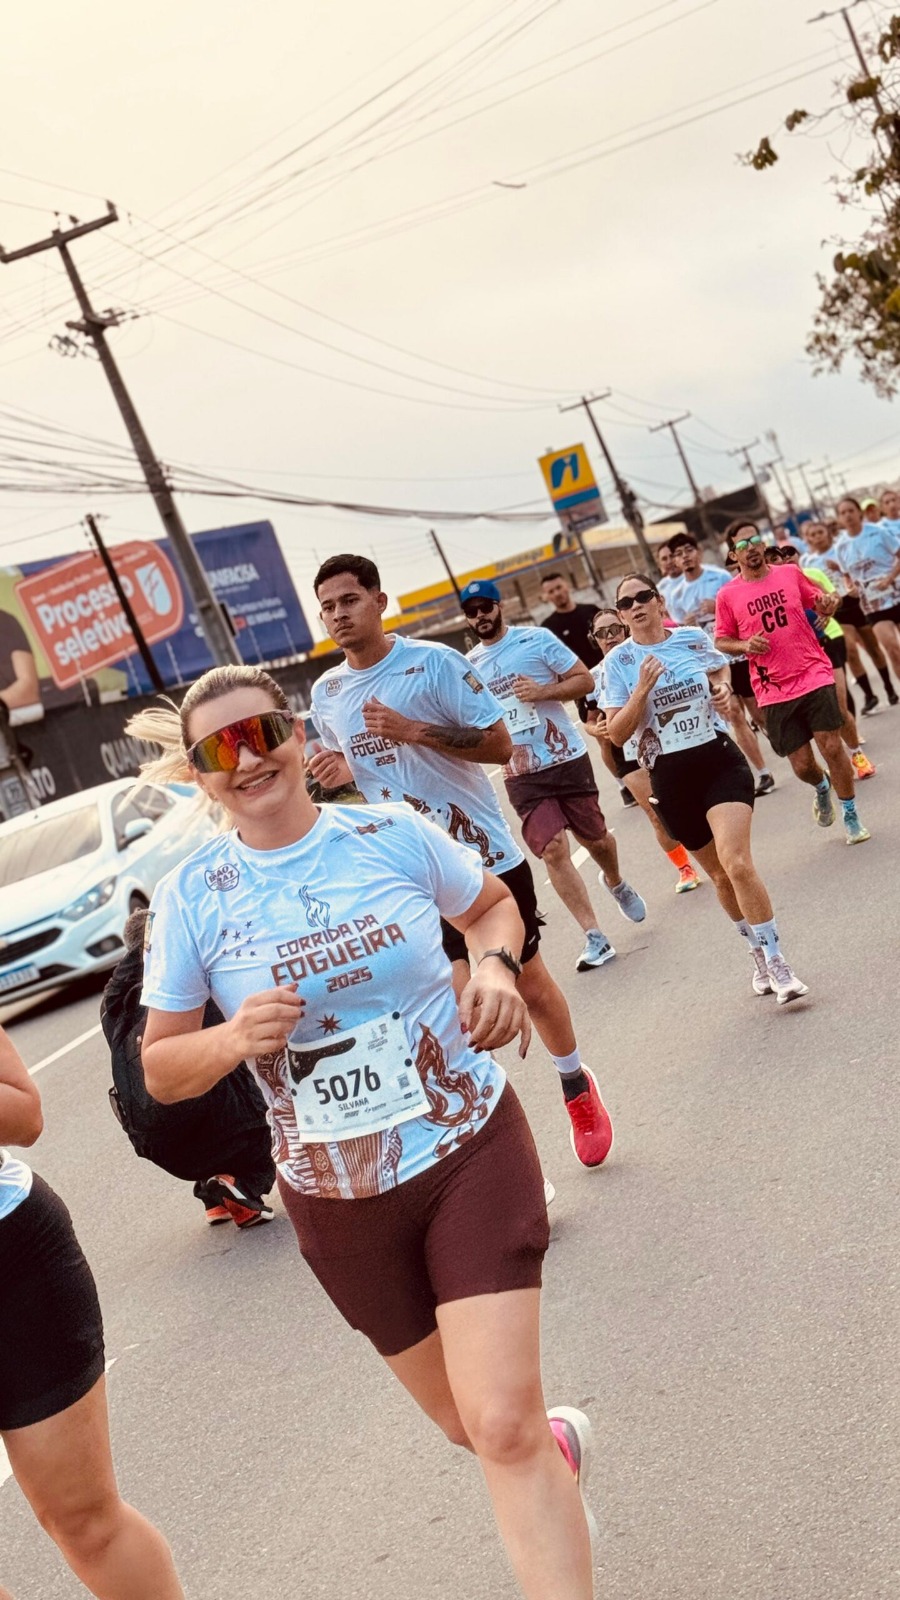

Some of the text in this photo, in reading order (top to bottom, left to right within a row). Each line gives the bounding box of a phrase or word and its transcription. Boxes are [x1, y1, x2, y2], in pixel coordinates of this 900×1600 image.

[746, 588, 788, 617] CORRE
[761, 605, 789, 634] CG
[653, 683, 704, 710] FOGUEIRA
[654, 677, 696, 697] CORRIDA DA
[673, 715, 700, 734] 1037
[374, 753, 397, 767] 2025
[276, 914, 379, 958] CORRIDA DA
[270, 922, 407, 987] FOGUEIRA
[325, 966, 373, 993] 2025
[312, 1065, 381, 1105] 5076
[337, 1097, 370, 1111] SILVANA
